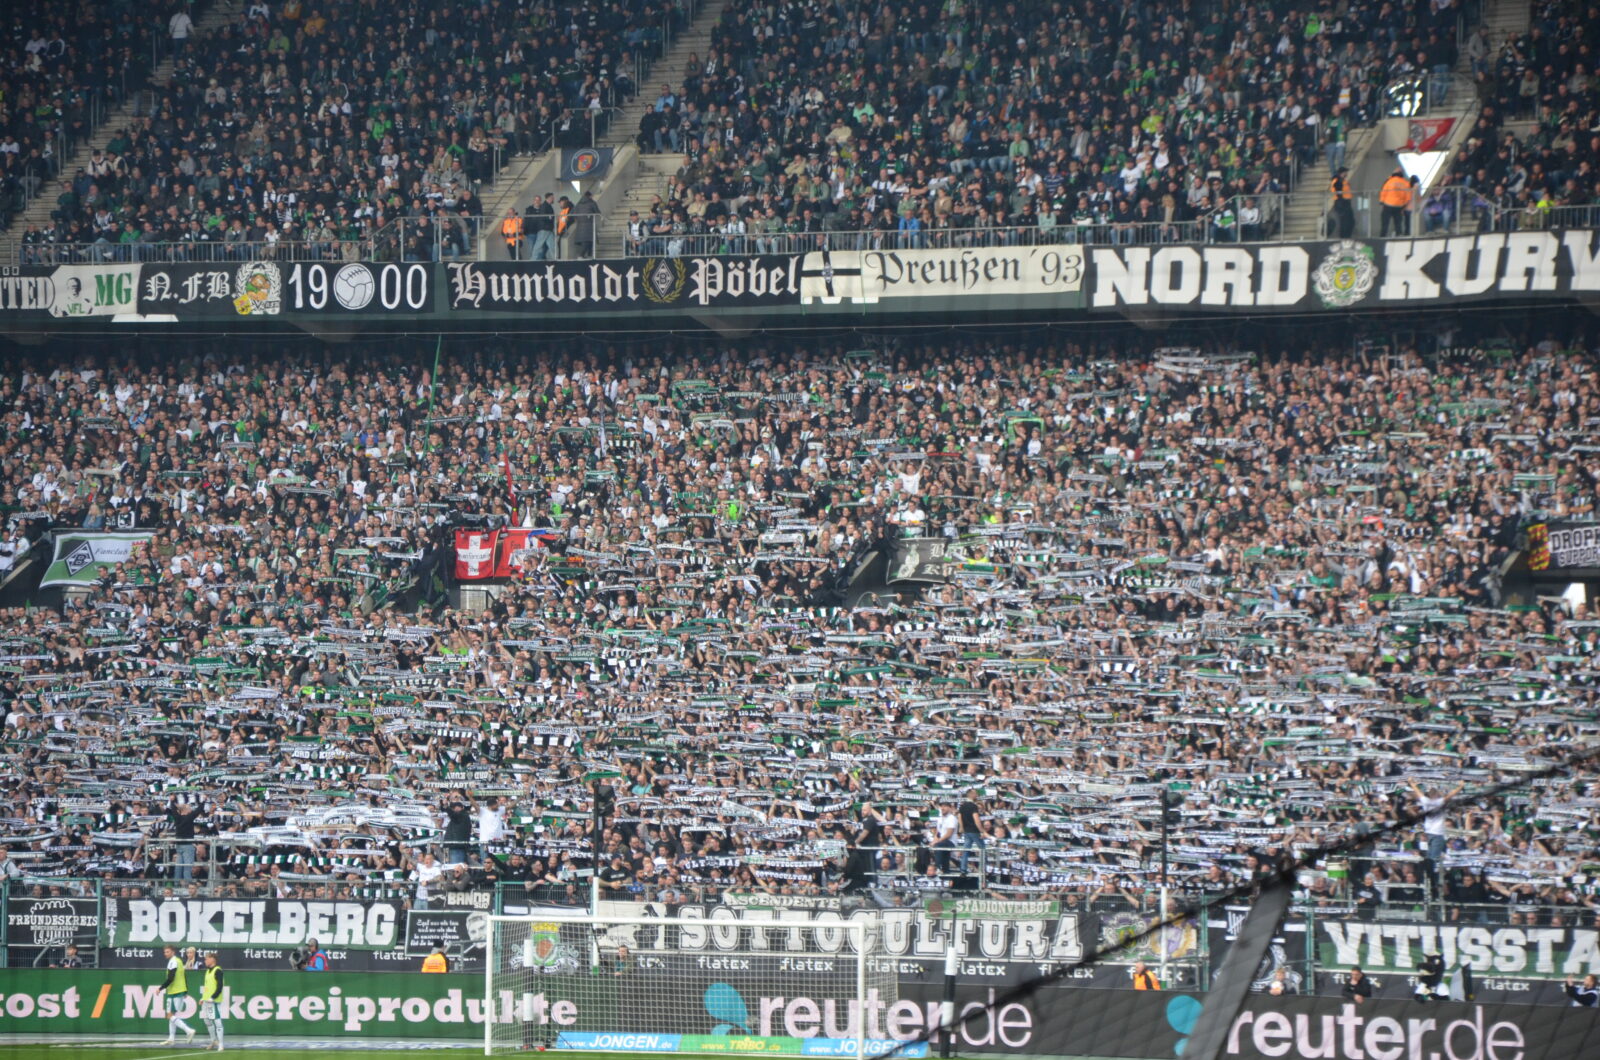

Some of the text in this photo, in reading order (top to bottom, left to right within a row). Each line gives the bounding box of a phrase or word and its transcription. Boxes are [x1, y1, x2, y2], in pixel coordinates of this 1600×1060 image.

[448, 262, 640, 309] Humboldt
[689, 255, 801, 306] Pöbel
[865, 248, 1020, 291] Preußen
[1092, 245, 1309, 307] NORD
[0, 276, 55, 310] TED
[94, 272, 132, 307] MG
[8, 913, 99, 927] FREUNDESKREIS
[128, 896, 397, 946] BÖKELBERG
[955, 900, 1052, 914] STADIONVERBOT
[678, 904, 1083, 961] SOTTOCULTURA
[115, 947, 154, 958] flatex
[243, 948, 282, 959] flatex
[698, 956, 749, 970] flatex
[781, 957, 833, 972] flatex
[866, 959, 919, 975] flatex
[0, 985, 80, 1018] ost
[1482, 979, 1530, 991] flatex
[758, 986, 1033, 1048] reuter.de
[1226, 1004, 1526, 1060] reuter.de
[589, 1034, 659, 1049] JONGEN
